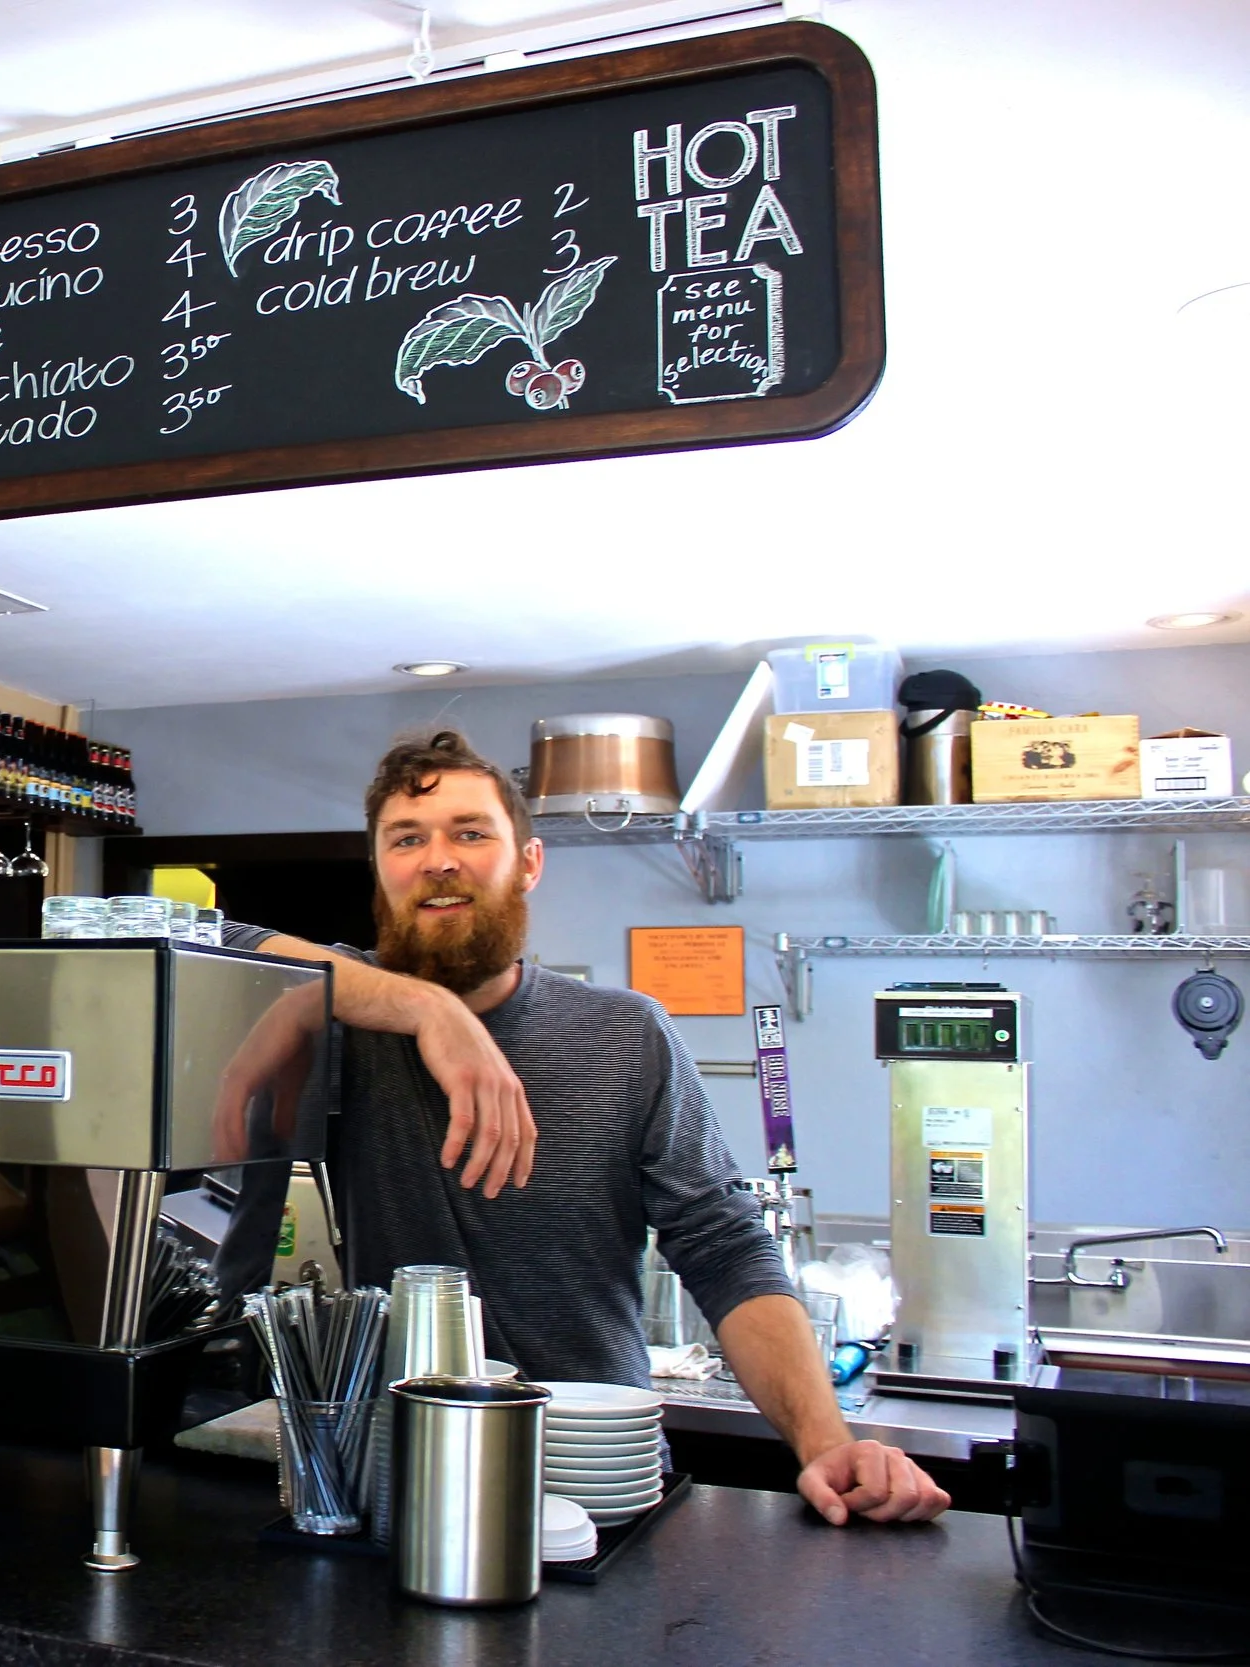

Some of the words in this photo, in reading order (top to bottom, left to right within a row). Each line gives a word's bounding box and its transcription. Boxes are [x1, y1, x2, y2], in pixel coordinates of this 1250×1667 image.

[633, 104, 797, 201] HOT
[168, 194, 199, 236] 3
[262, 217, 356, 266] drip
[366, 194, 524, 251] coffee
[554, 182, 590, 220] 2
[637, 184, 804, 272] TEA
[166, 239, 208, 278] 4
[256, 265, 359, 316] cold
[366, 254, 476, 301] brew
[542, 228, 582, 274] 3
[161, 290, 217, 329] 4
[685, 280, 741, 299] see
[672, 300, 756, 324] menu
[688, 324, 744, 343] for
